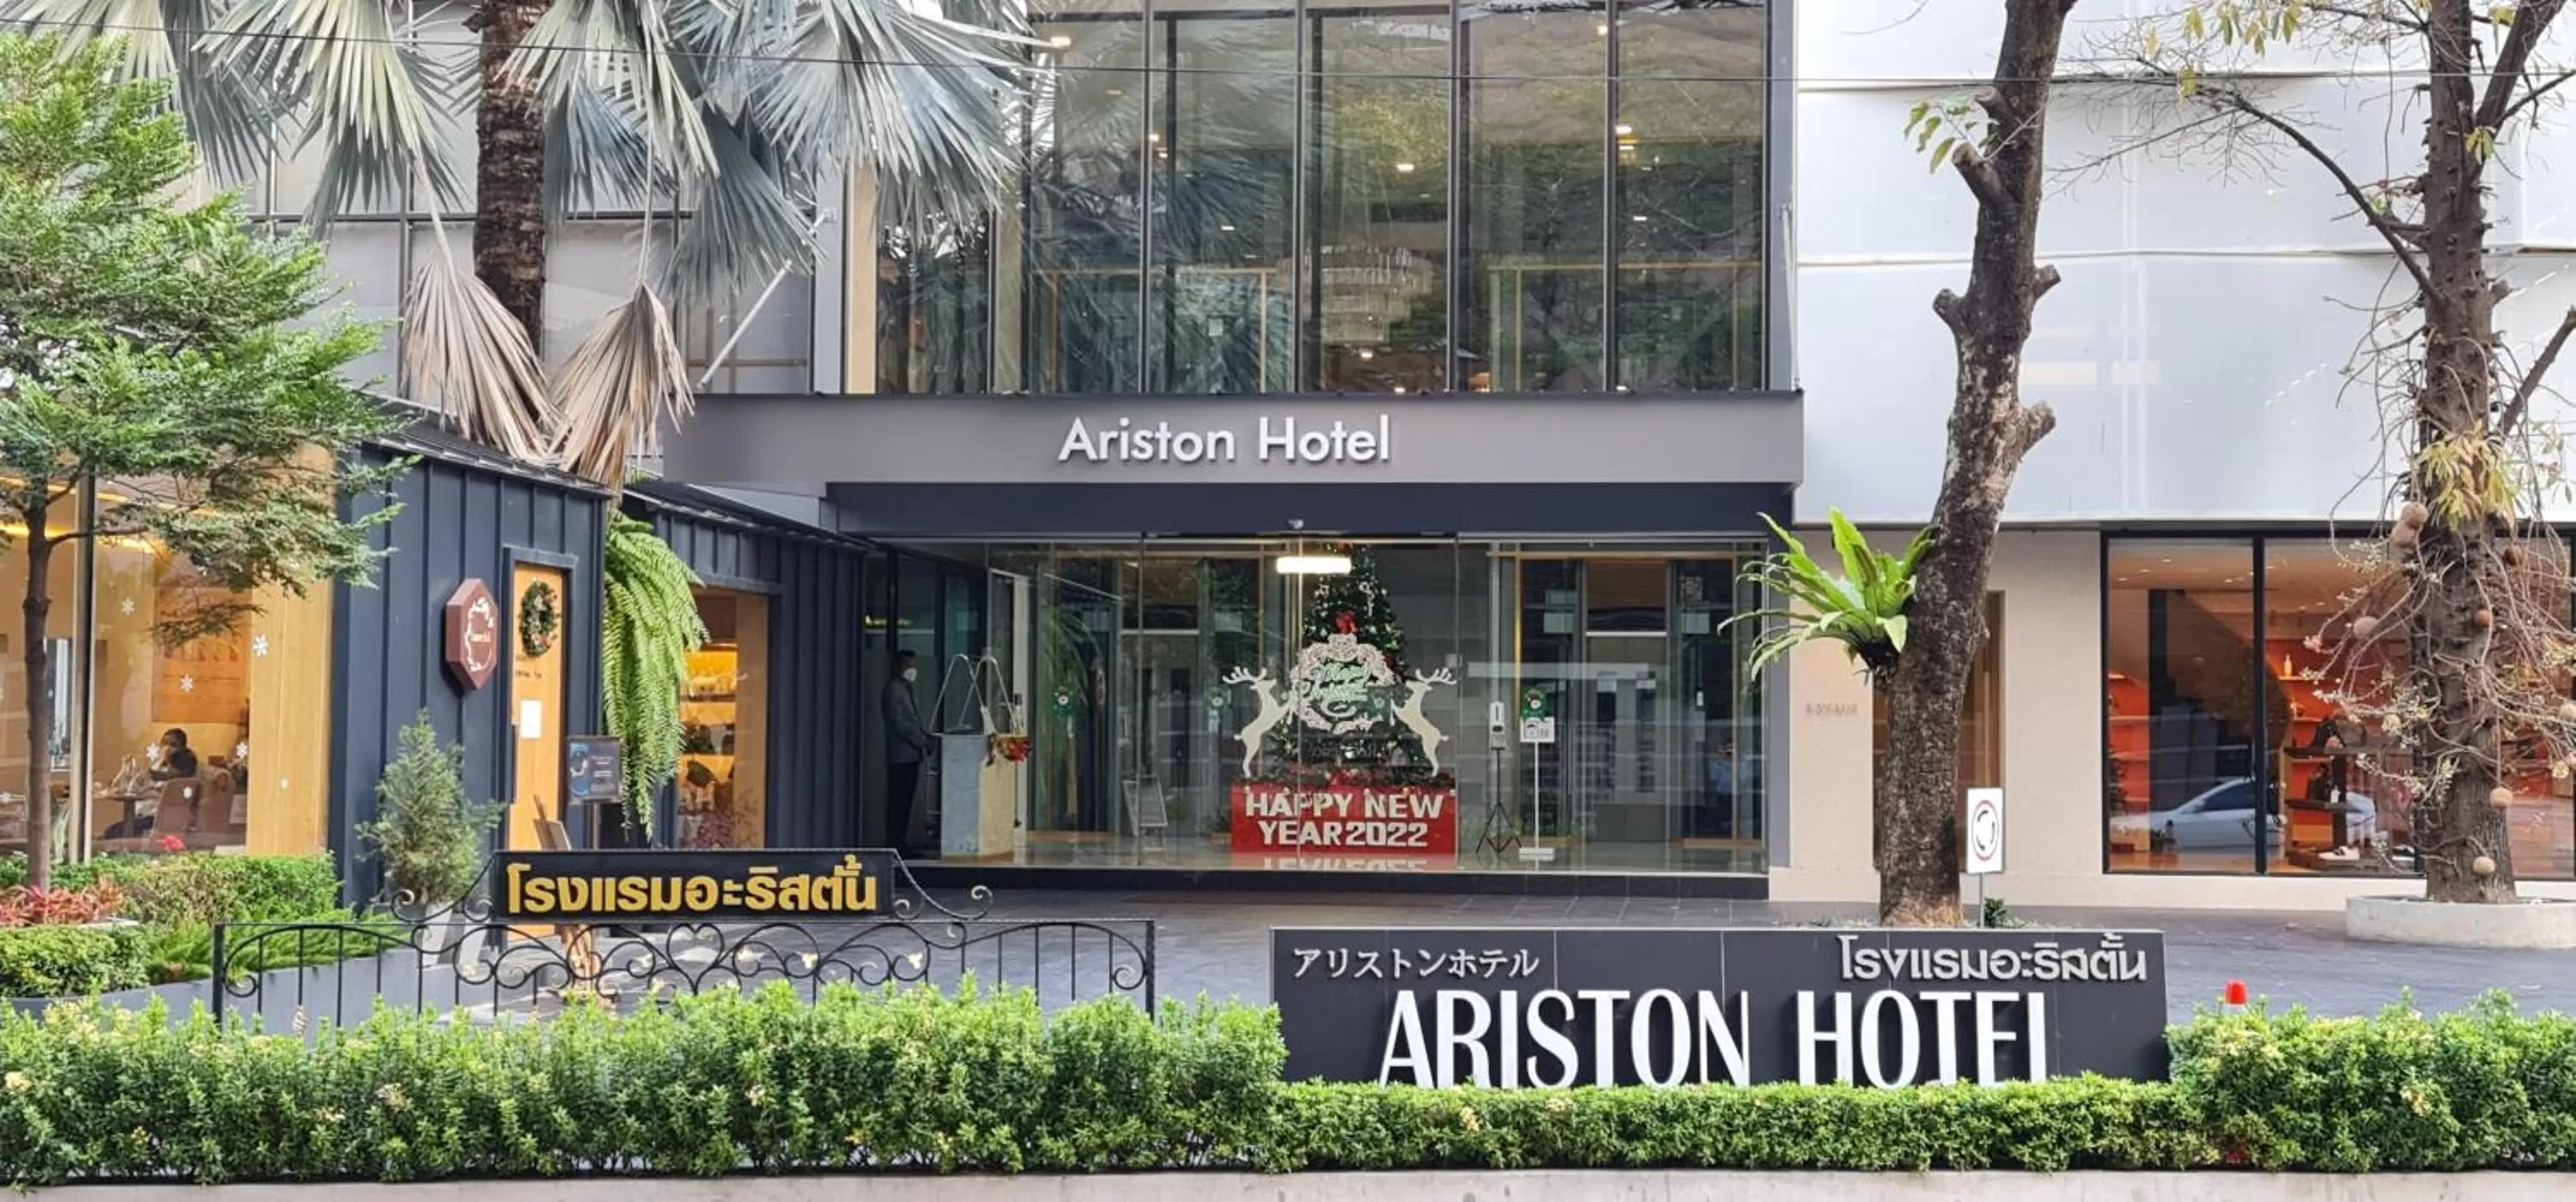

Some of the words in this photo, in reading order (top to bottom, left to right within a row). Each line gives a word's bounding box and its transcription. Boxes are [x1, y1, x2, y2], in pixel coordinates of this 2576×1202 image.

[1058, 416, 1236, 461] Ariston
[1258, 414, 1390, 461] Hotel
[1245, 792, 1353, 818] HAPPY
[1364, 792, 1445, 819] NEW
[506, 854, 877, 914] โรงแรมอะริสตั้น
[1291, 947, 1540, 980] アリストンホテル
[1837, 932, 2148, 981] โรงแรมอะริสตั้น
[1377, 988, 1751, 1089] ARISTON
